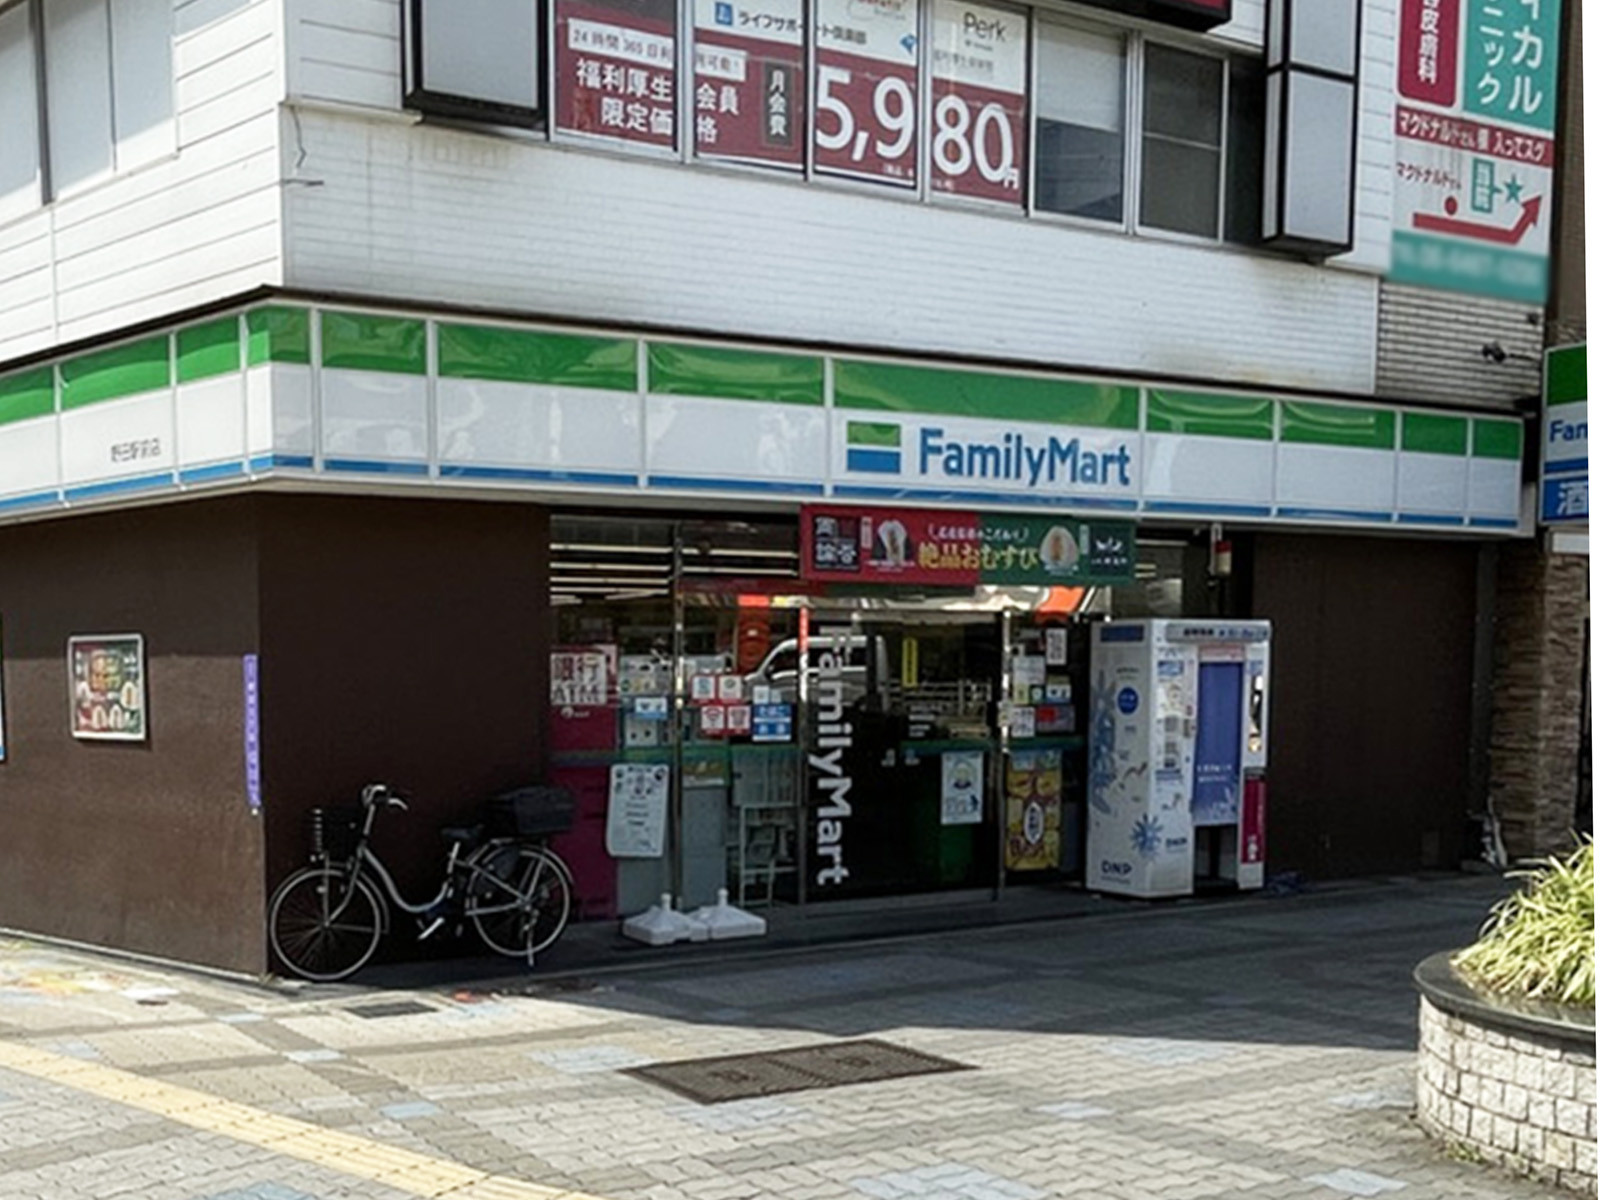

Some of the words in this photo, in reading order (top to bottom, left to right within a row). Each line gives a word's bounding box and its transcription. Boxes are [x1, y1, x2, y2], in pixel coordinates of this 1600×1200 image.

[963, 11, 1006, 42] Perk
[1418, 0, 1440, 85] 皮膚科
[768, 69, 788, 138] 月会費
[920, 426, 1131, 487] FamilyMart
[808, 626, 853, 886] FamilyMart
[1101, 860, 1133, 875] DNP
